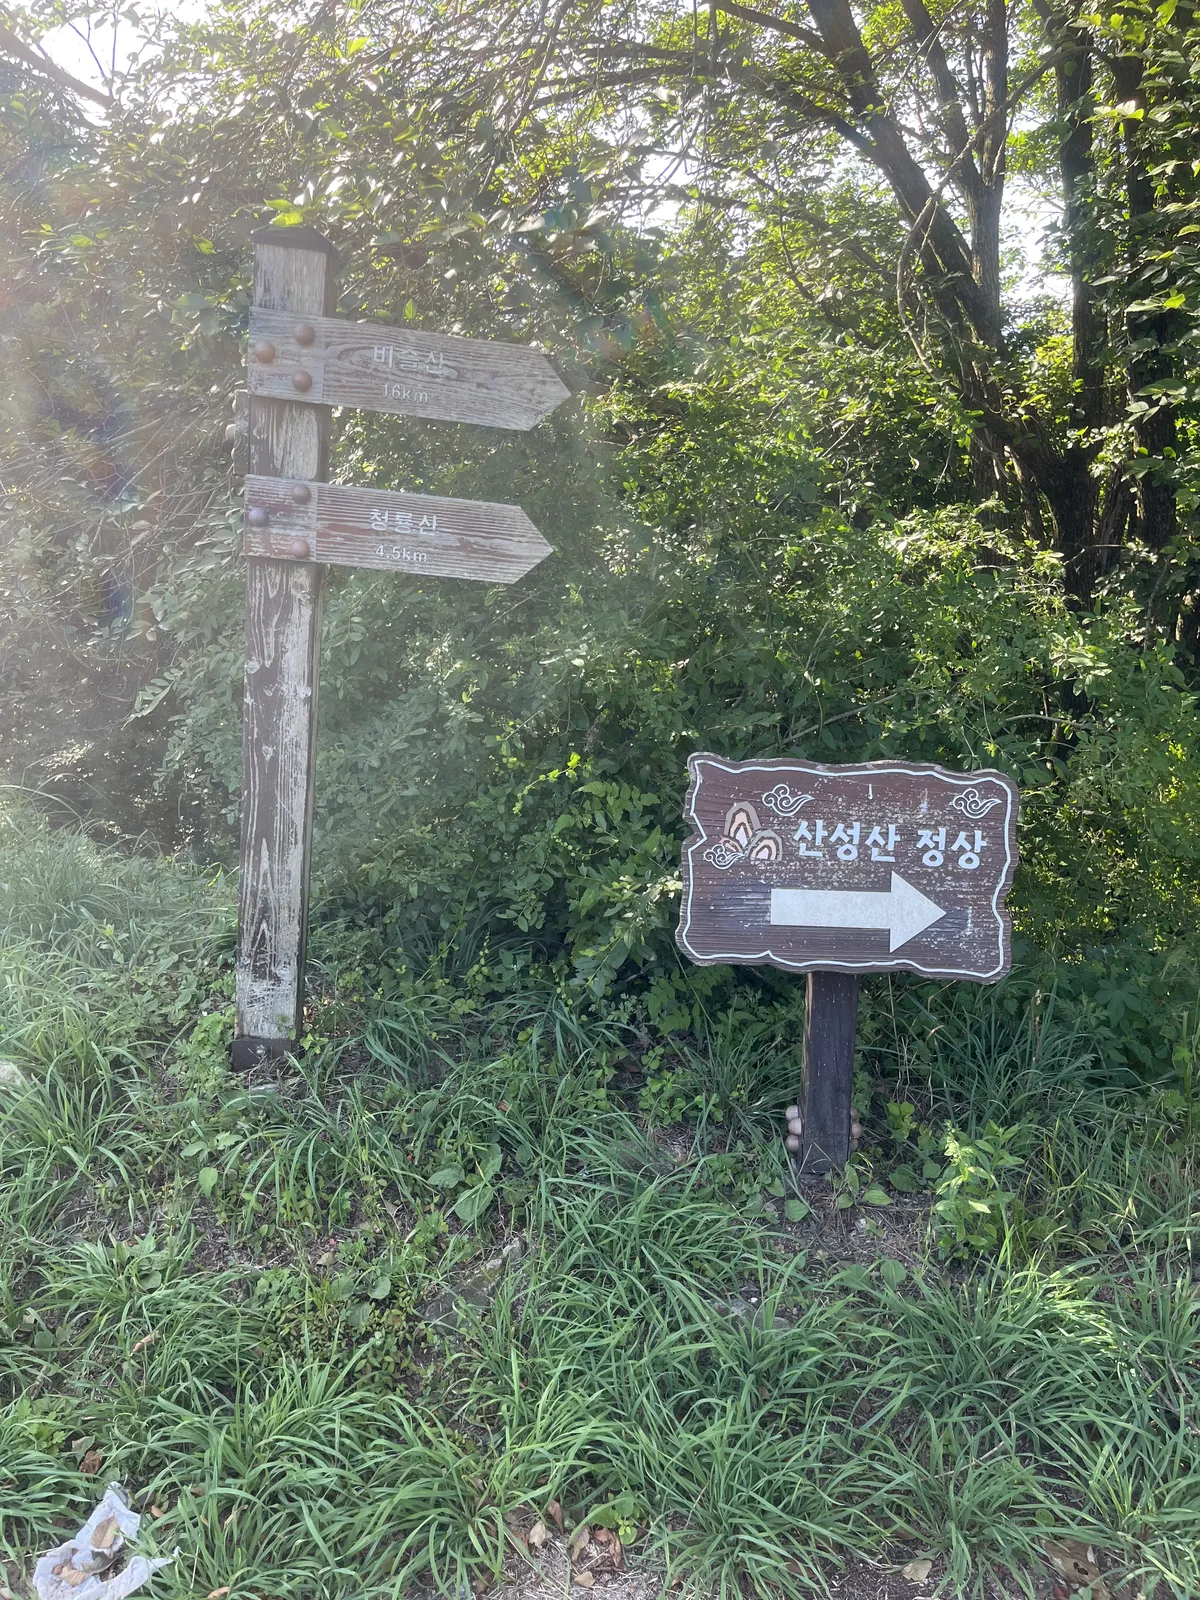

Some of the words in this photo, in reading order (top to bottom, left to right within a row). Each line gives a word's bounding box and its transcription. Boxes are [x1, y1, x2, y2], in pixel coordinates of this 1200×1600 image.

[373, 345, 445, 376] 비슬산
[369, 508, 439, 536] 청룡산
[375, 544, 427, 562] 4.5km
[793, 819, 900, 863] 산성산
[916, 827, 986, 870] 정상
